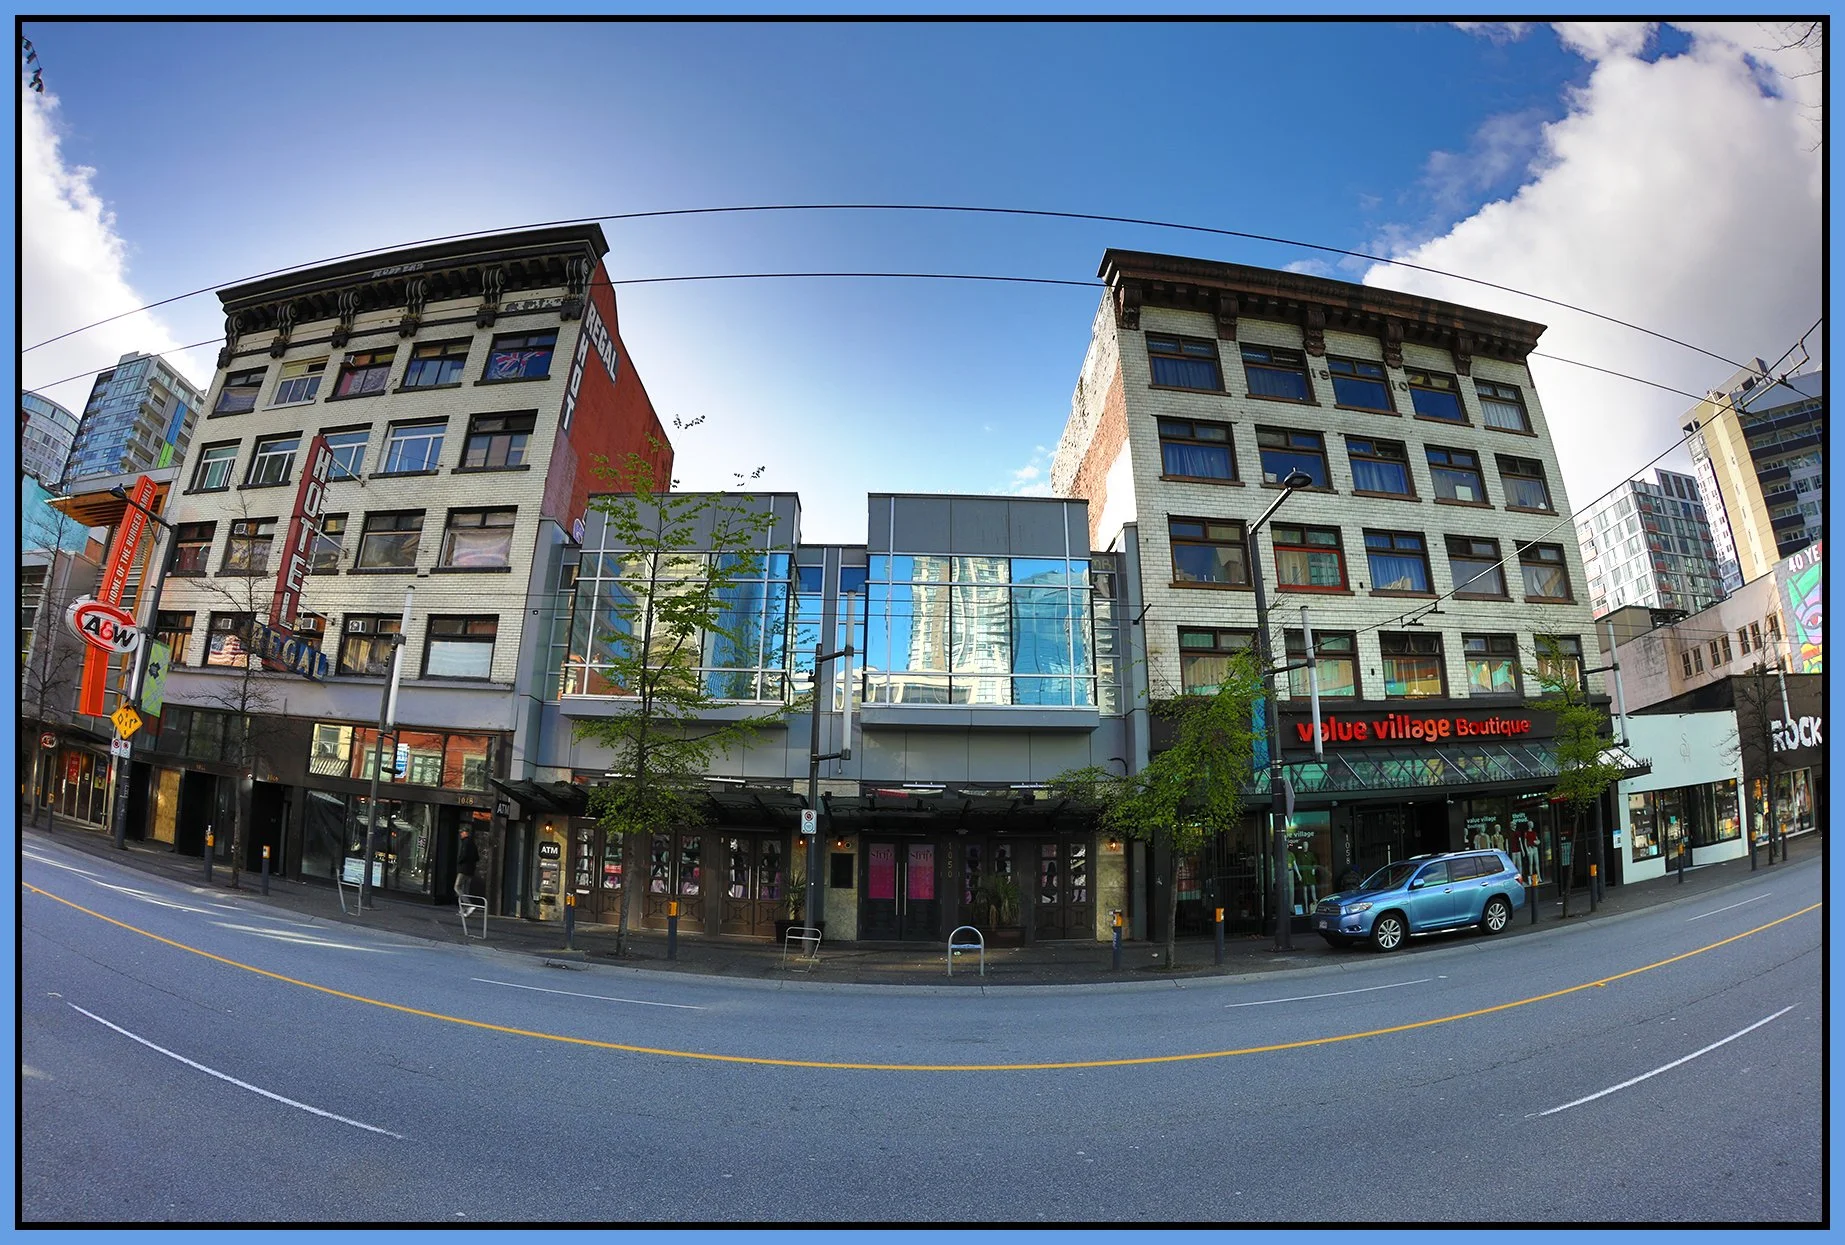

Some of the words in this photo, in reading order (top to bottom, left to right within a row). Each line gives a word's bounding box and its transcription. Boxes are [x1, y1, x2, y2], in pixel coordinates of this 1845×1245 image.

[585, 300, 617, 382] REGAL
[1310, 368, 1330, 381] 19
[1391, 379, 1408, 392] 10
[139, 482, 154, 514] AMILY
[125, 513, 143, 548] BURGER
[278, 446, 333, 631] HOTEL
[116, 564, 126, 578] OF
[120, 546, 132, 566] THE
[1788, 553, 1804, 573] 40
[108, 577, 122, 605] HOME
[83, 613, 136, 648] A&W
[251, 621, 324, 681] REGAL
[1296, 716, 1368, 742] value
[1372, 713, 1451, 743] village
[1455, 717, 1531, 737] Boutique
[1769, 715, 1822, 752] ROCK
[541, 846, 559, 855] ATM
